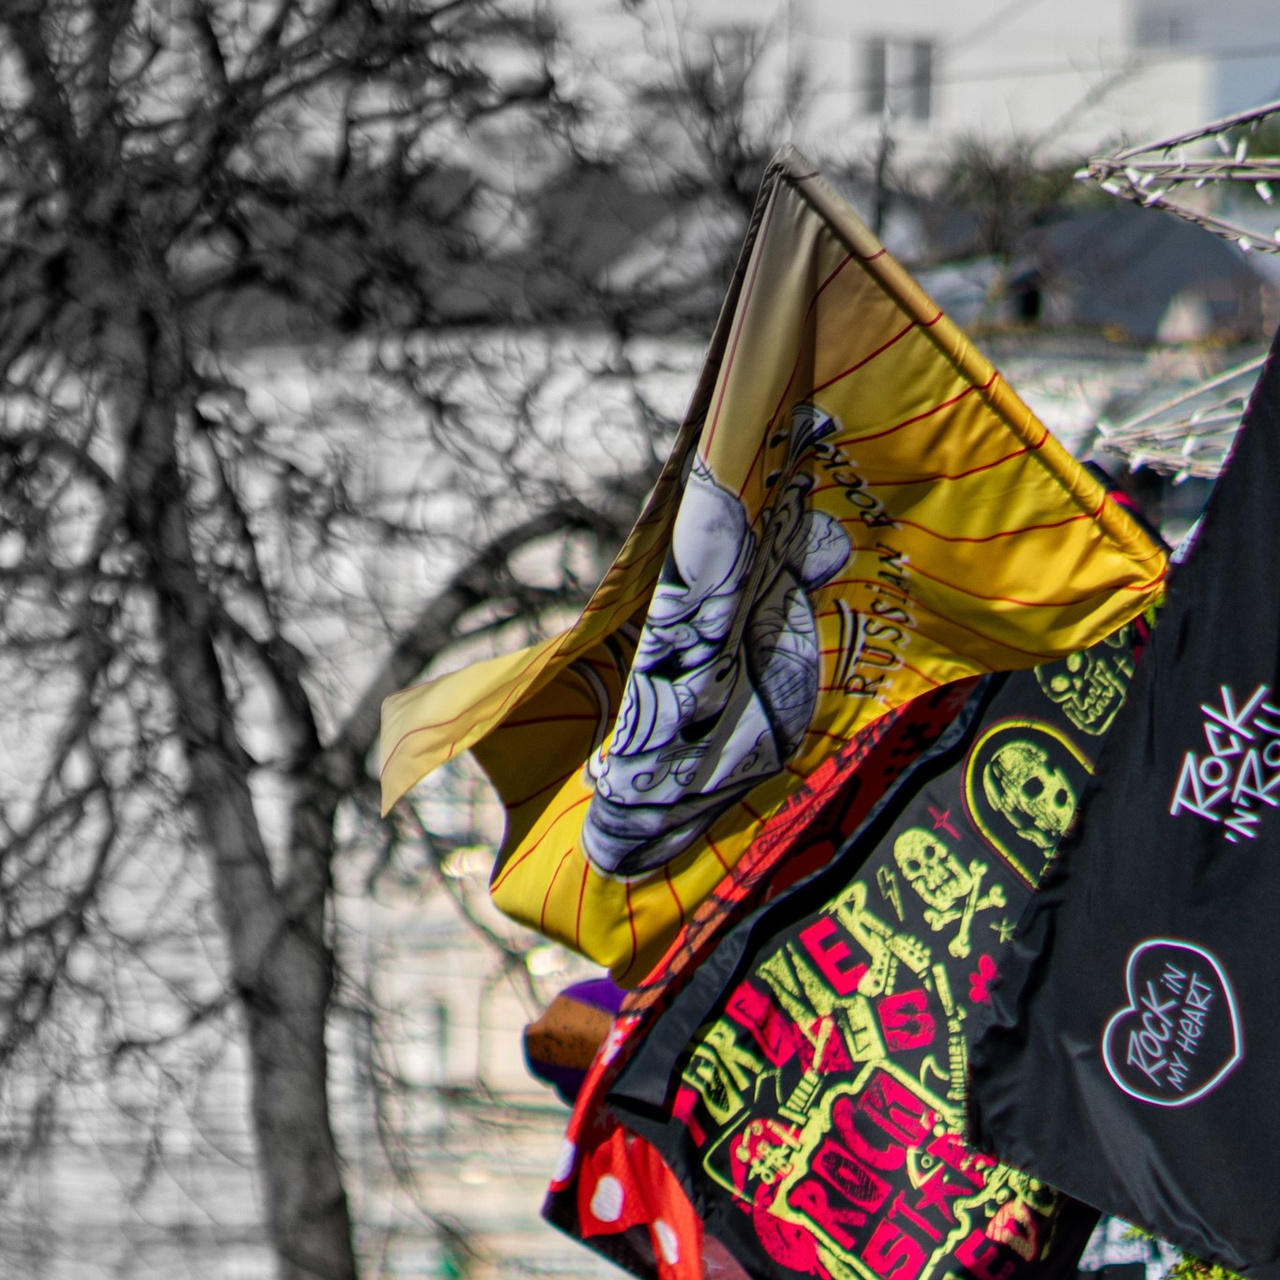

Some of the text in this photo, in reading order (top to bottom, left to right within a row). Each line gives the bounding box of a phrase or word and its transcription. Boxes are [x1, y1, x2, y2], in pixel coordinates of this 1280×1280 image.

[1169, 683, 1271, 822] ROCK
[1126, 980, 1178, 1087] ROCK
[1166, 1051, 1189, 1092] MY
